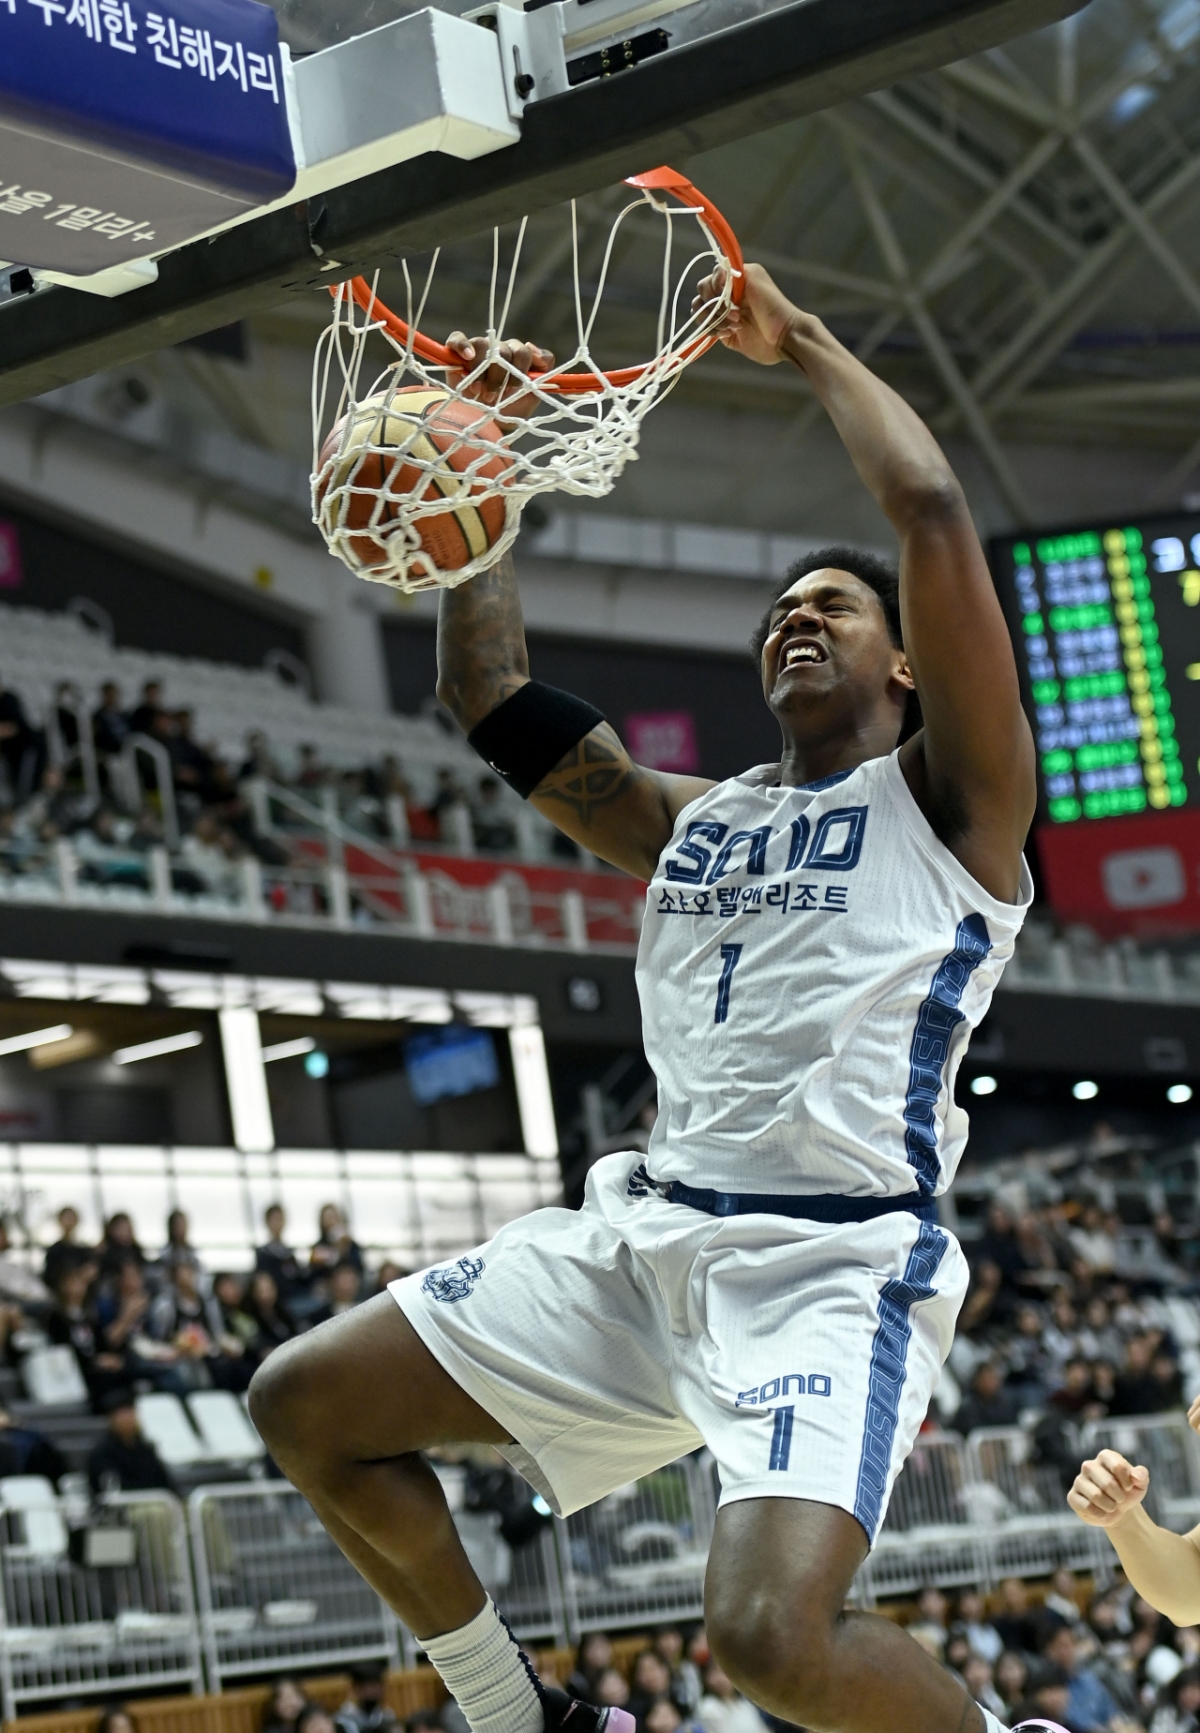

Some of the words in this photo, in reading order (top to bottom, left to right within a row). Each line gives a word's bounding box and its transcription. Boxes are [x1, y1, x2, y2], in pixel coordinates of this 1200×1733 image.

[146, 12, 279, 104] 친해지리
[43, 204, 156, 242] 1밀리+
[715, 944, 743, 1024] 1
[768, 1405, 795, 1471] 1
